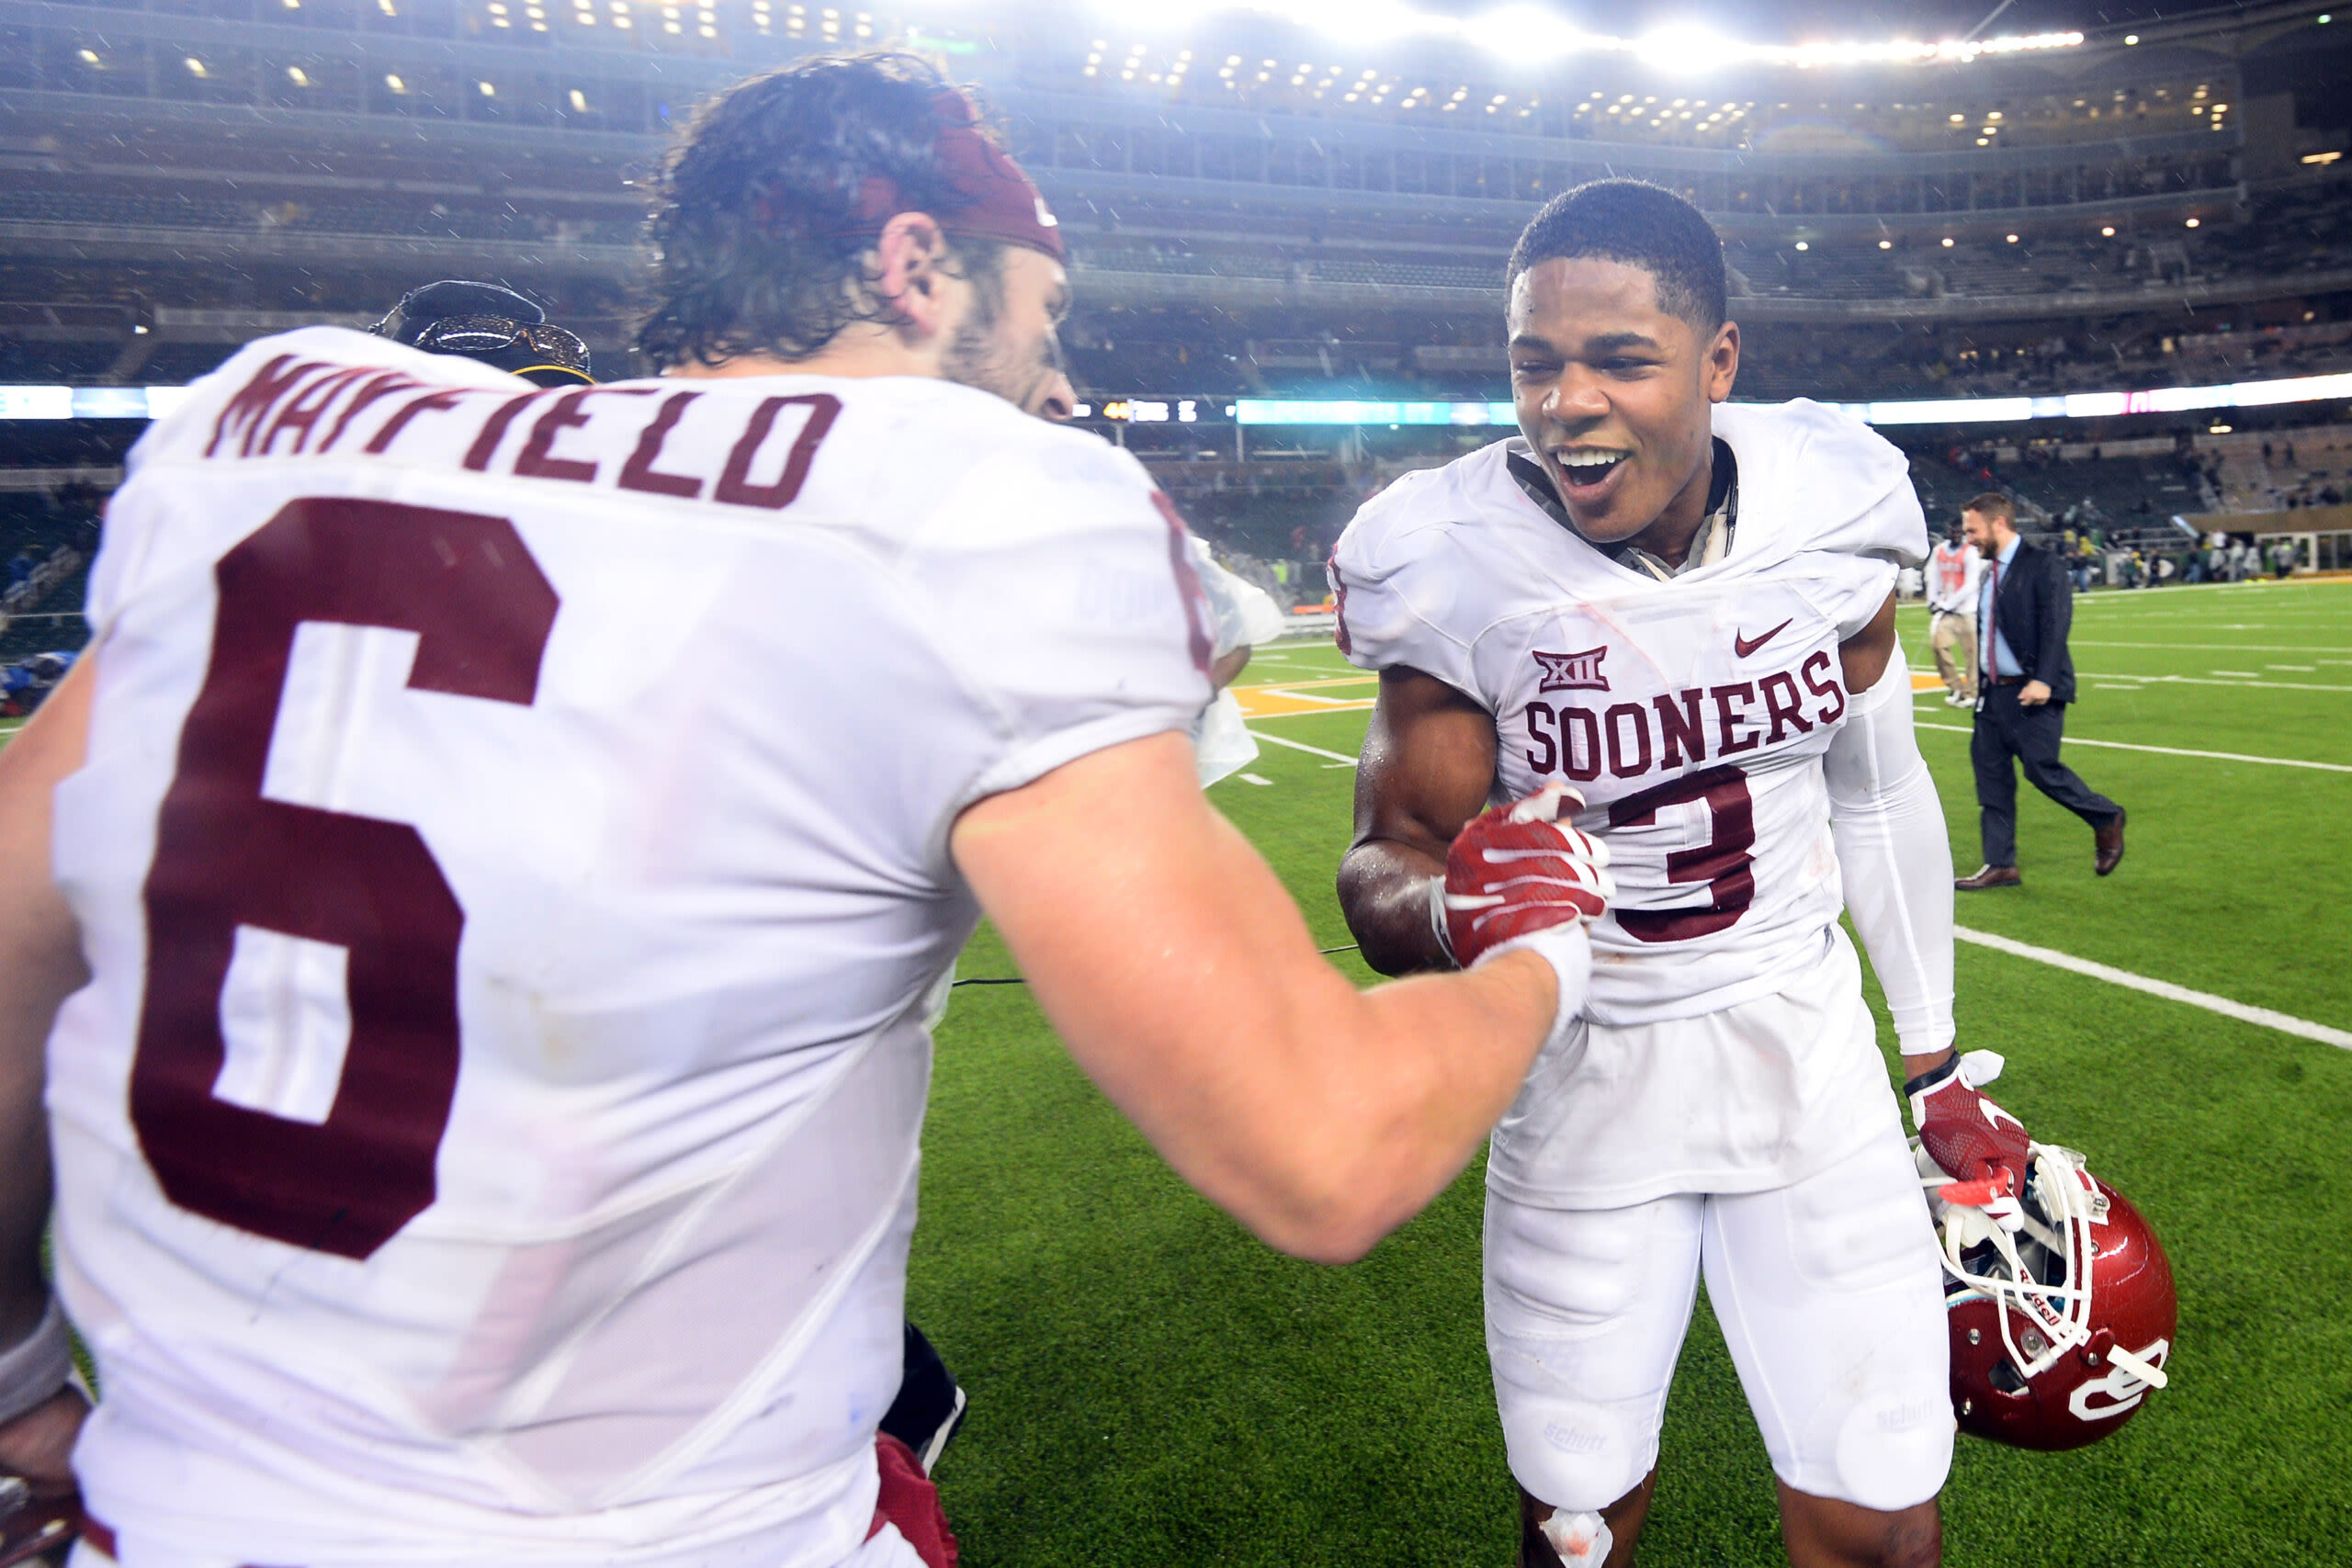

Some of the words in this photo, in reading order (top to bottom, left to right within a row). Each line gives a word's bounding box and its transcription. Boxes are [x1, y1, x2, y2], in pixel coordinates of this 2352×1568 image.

[205, 353, 843, 510] MAYFIELD
[1526, 650, 1845, 782] SOONERS
[1532, 645, 1611, 694] XII
[130, 497, 561, 1262] 6
[1608, 765, 1756, 942] 3
[1544, 1421, 1607, 1450] schutt
